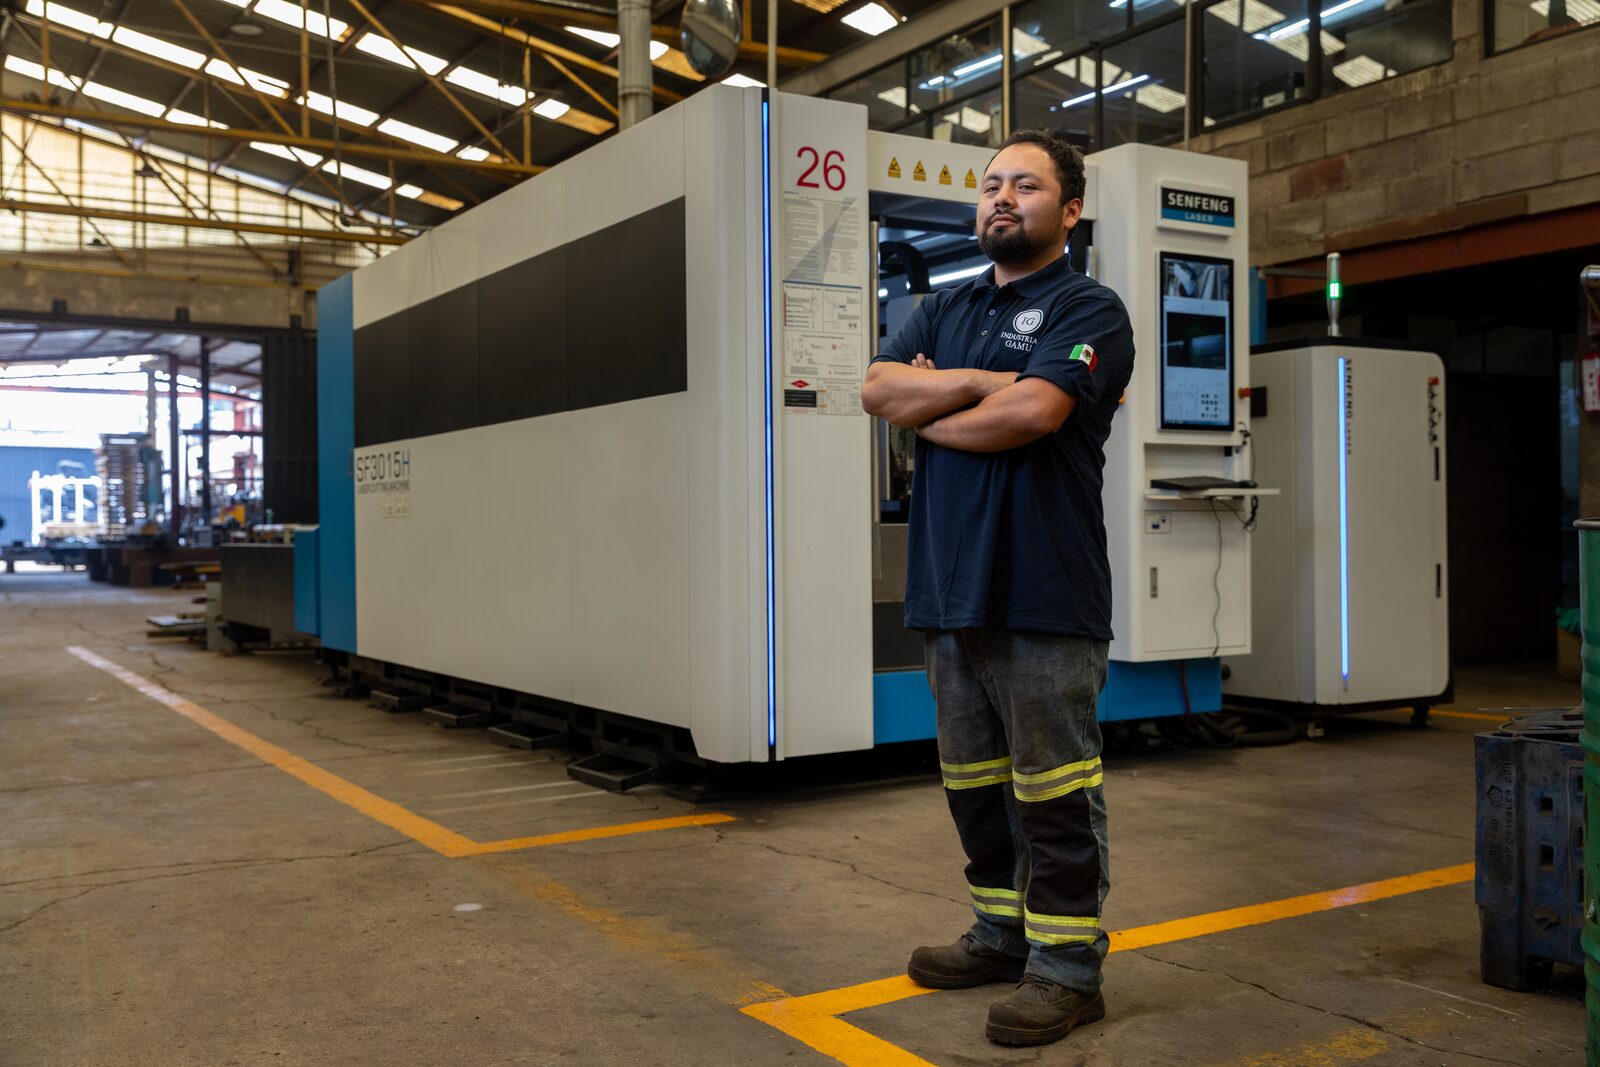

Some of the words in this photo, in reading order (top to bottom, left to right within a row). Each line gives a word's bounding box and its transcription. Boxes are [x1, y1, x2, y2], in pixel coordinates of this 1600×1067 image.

[797, 146, 846, 191] 26
[1168, 192, 1229, 213] SENFENG
[1184, 212, 1214, 222] LASER
[1021, 317, 1035, 326] IG
[1005, 340, 1032, 351] GAMU
[357, 449, 411, 482] SF3015H
